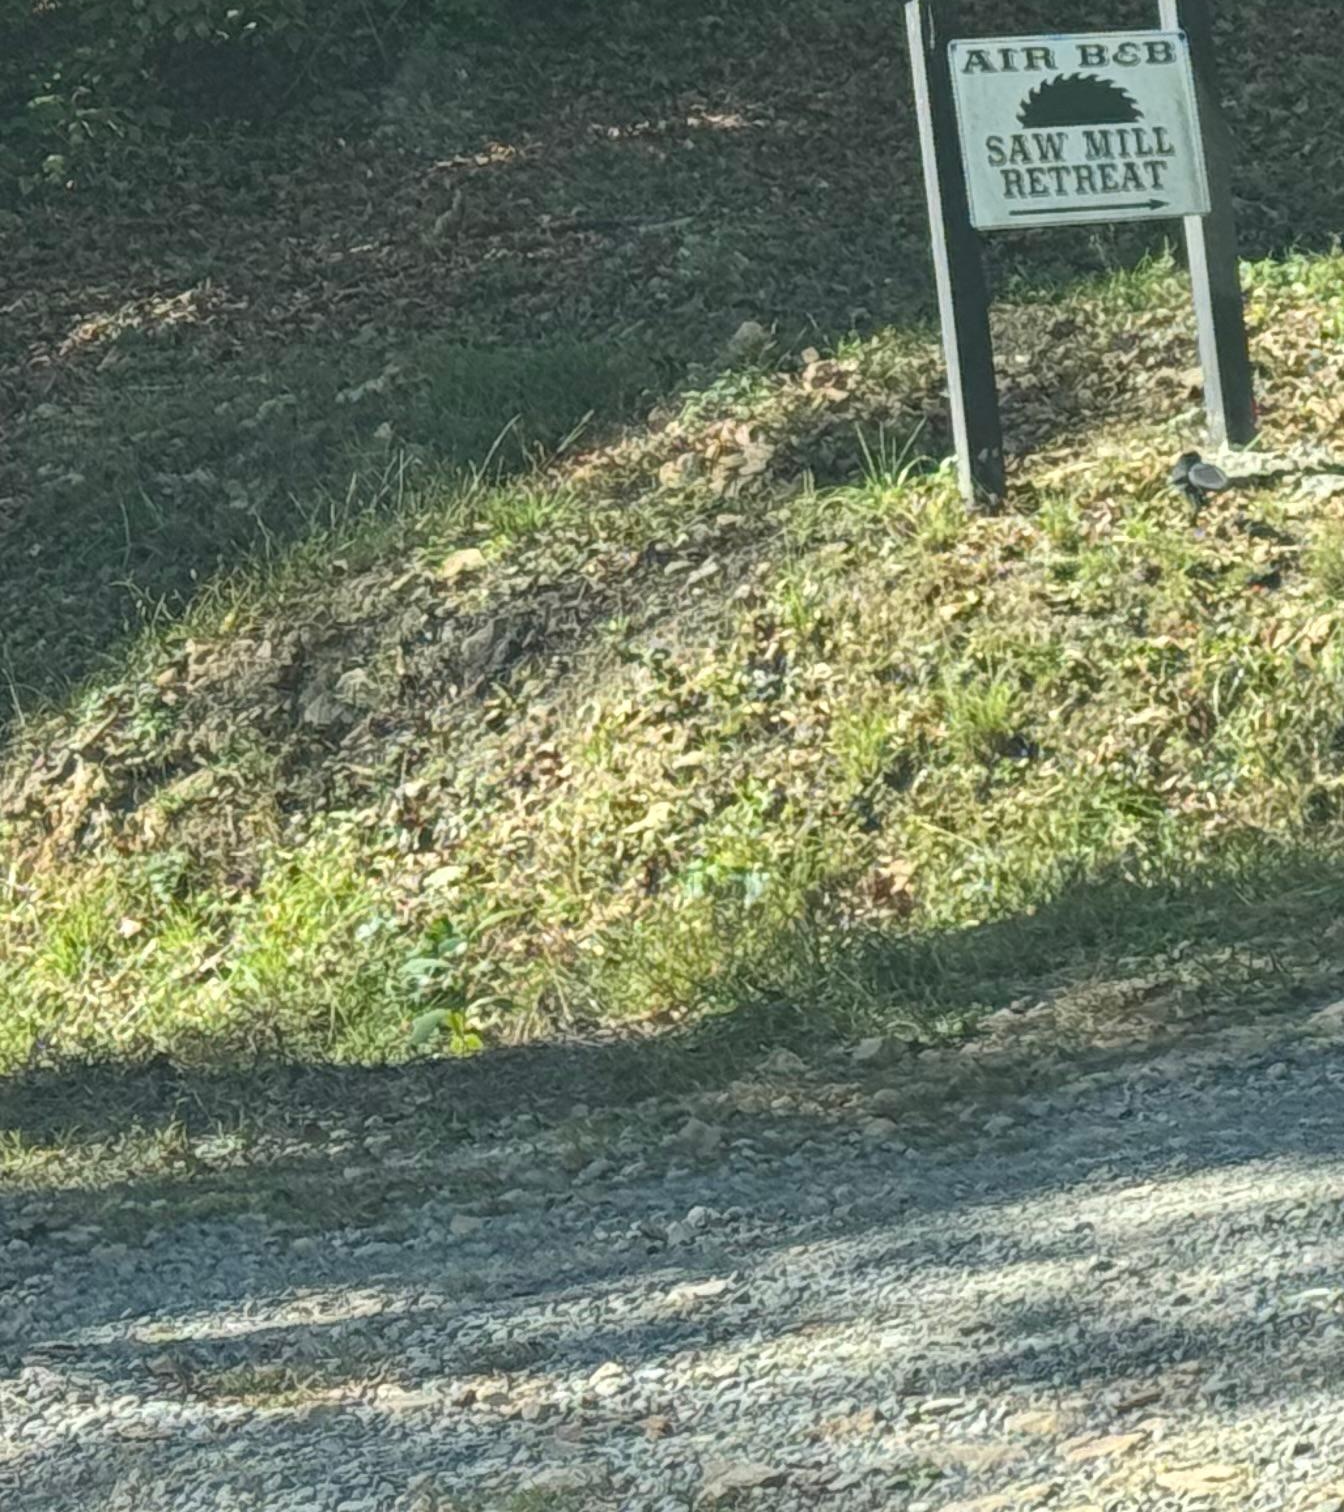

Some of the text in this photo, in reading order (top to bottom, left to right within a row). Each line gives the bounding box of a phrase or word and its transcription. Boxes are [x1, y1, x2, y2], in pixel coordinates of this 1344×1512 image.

[962, 40, 1177, 75] AIR B&B
[985, 126, 1175, 167] SAW MILL
[1000, 160, 1168, 199] RETREAT
